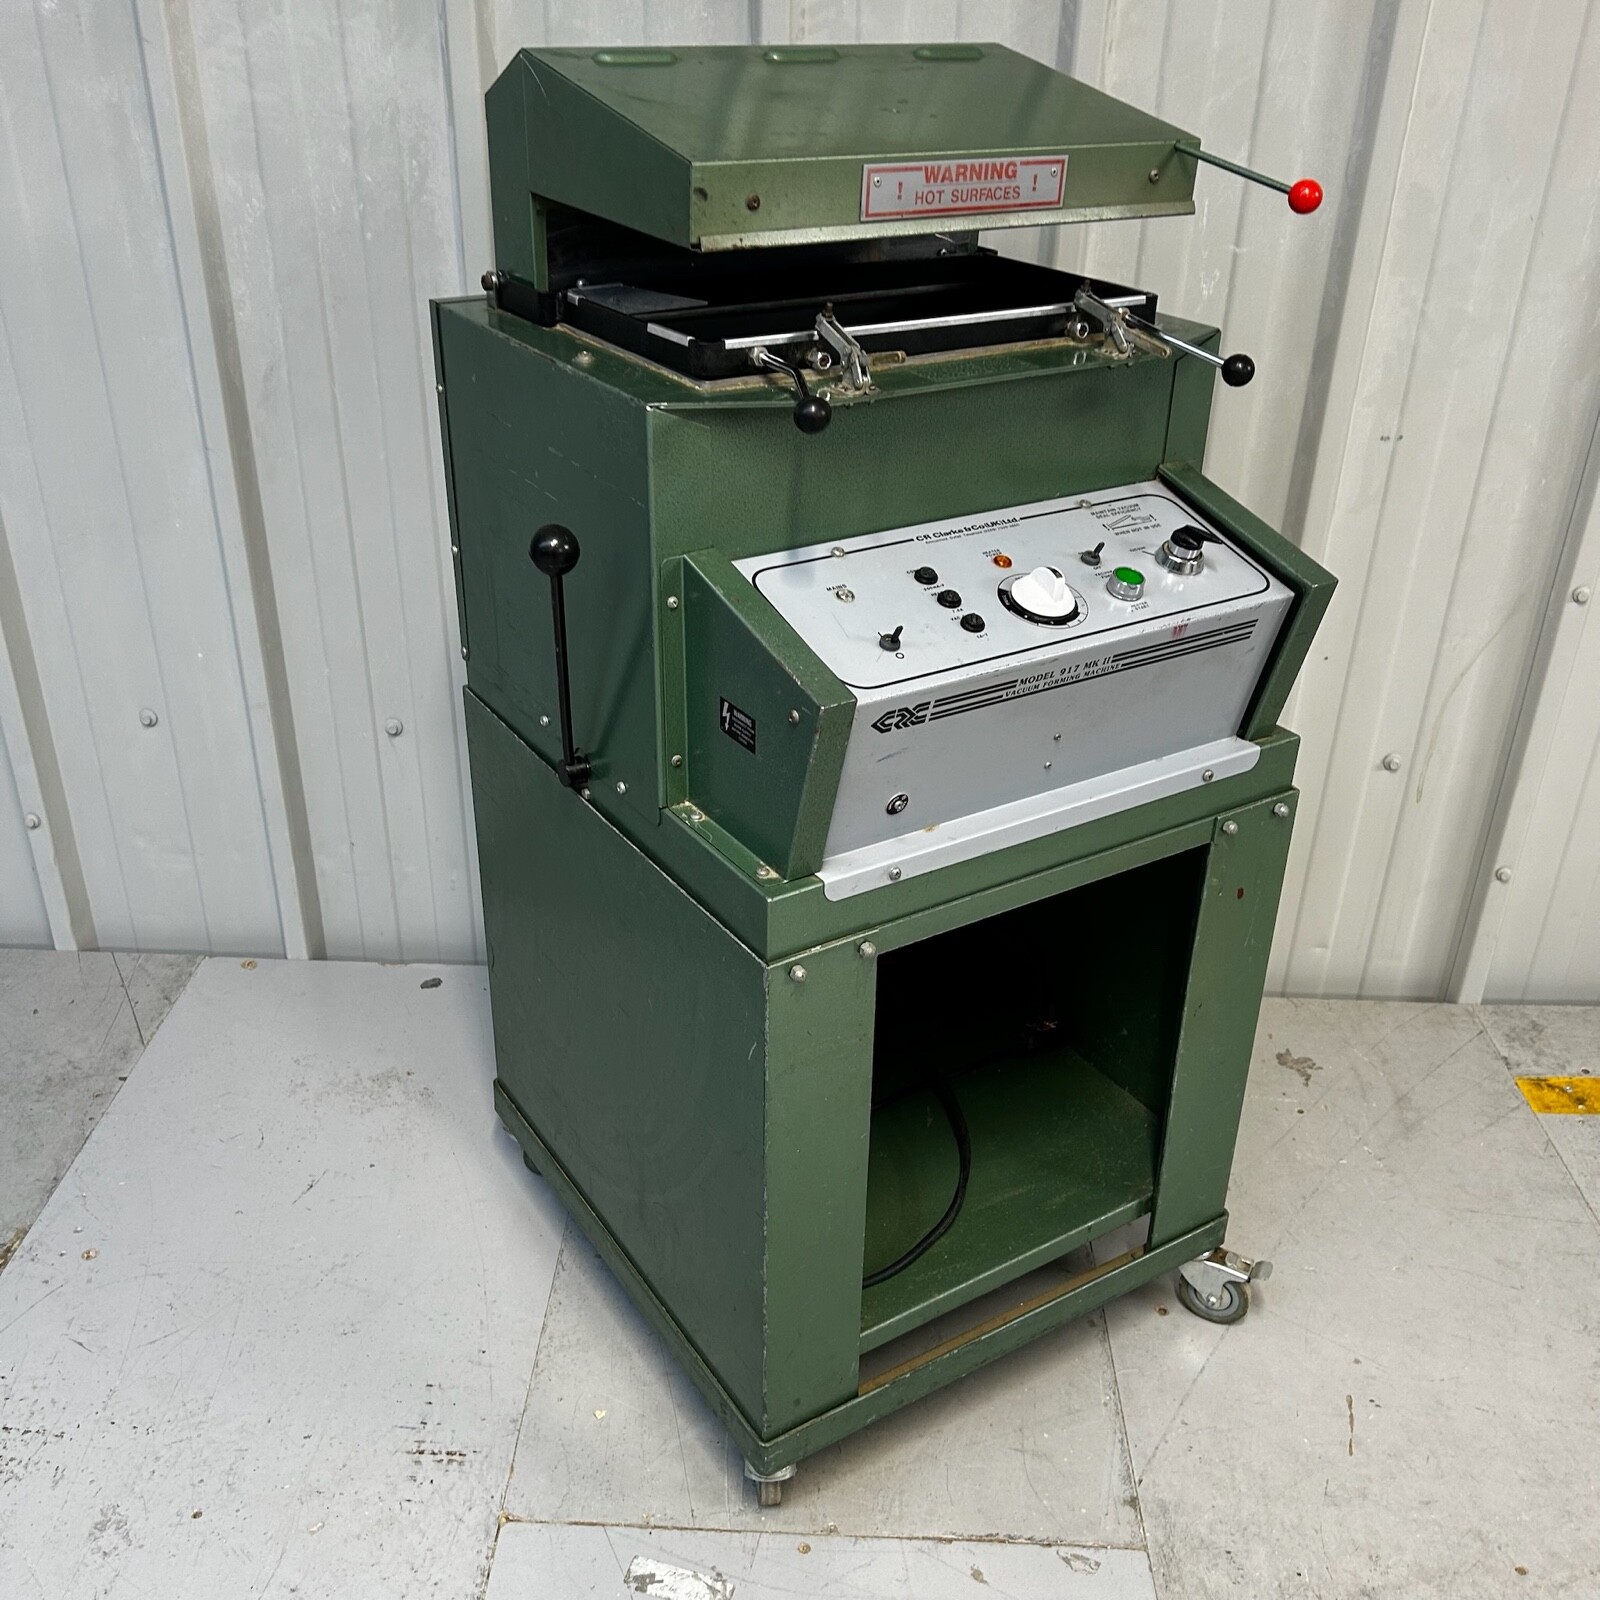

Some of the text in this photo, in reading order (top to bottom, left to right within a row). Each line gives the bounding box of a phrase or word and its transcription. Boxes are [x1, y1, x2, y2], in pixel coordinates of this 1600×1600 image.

[923, 161, 1018, 184] WARNING
[914, 189, 945, 206] HOT
[950, 185, 1021, 204] SURFACES
[1005, 663, 1121, 697] VACUUM FORMING MACHINE
[1018, 671, 1055, 686] MODEL
[1059, 664, 1081, 676] 917
[1083, 659, 1100, 671] MK
